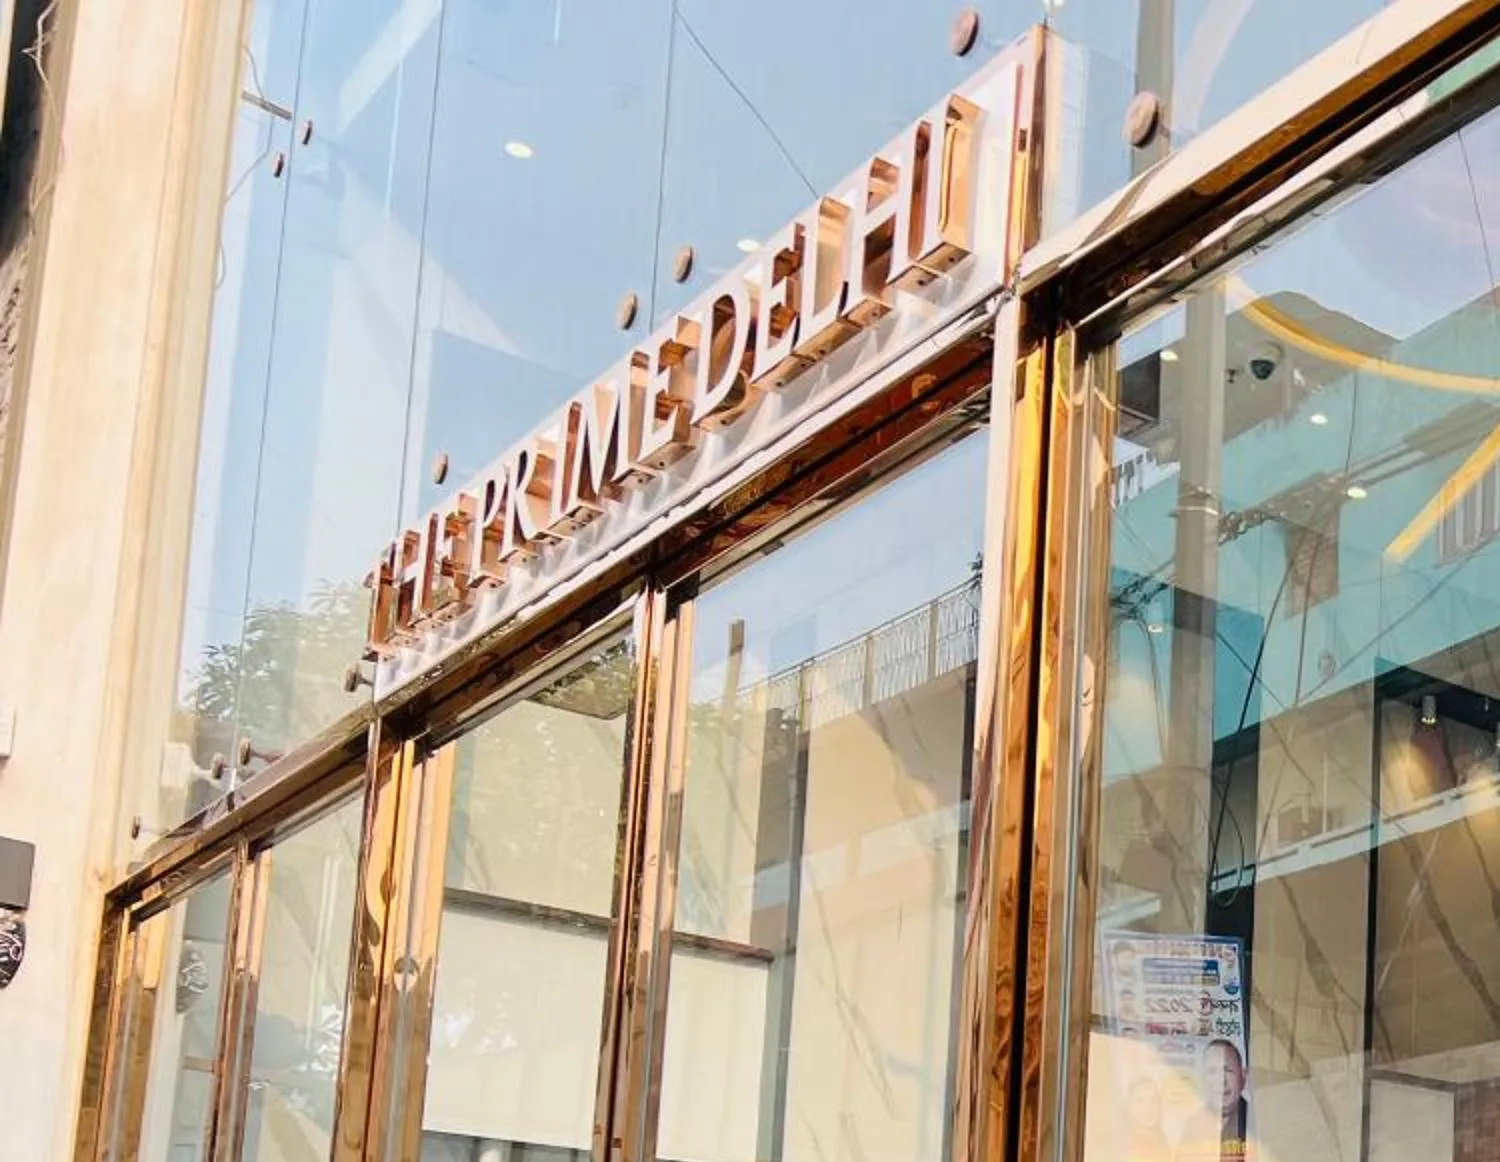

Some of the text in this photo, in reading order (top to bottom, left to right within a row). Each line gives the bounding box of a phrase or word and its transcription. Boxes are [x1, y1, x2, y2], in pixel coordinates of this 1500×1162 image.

[362, 93, 984, 660] THE PRIME DELHI
